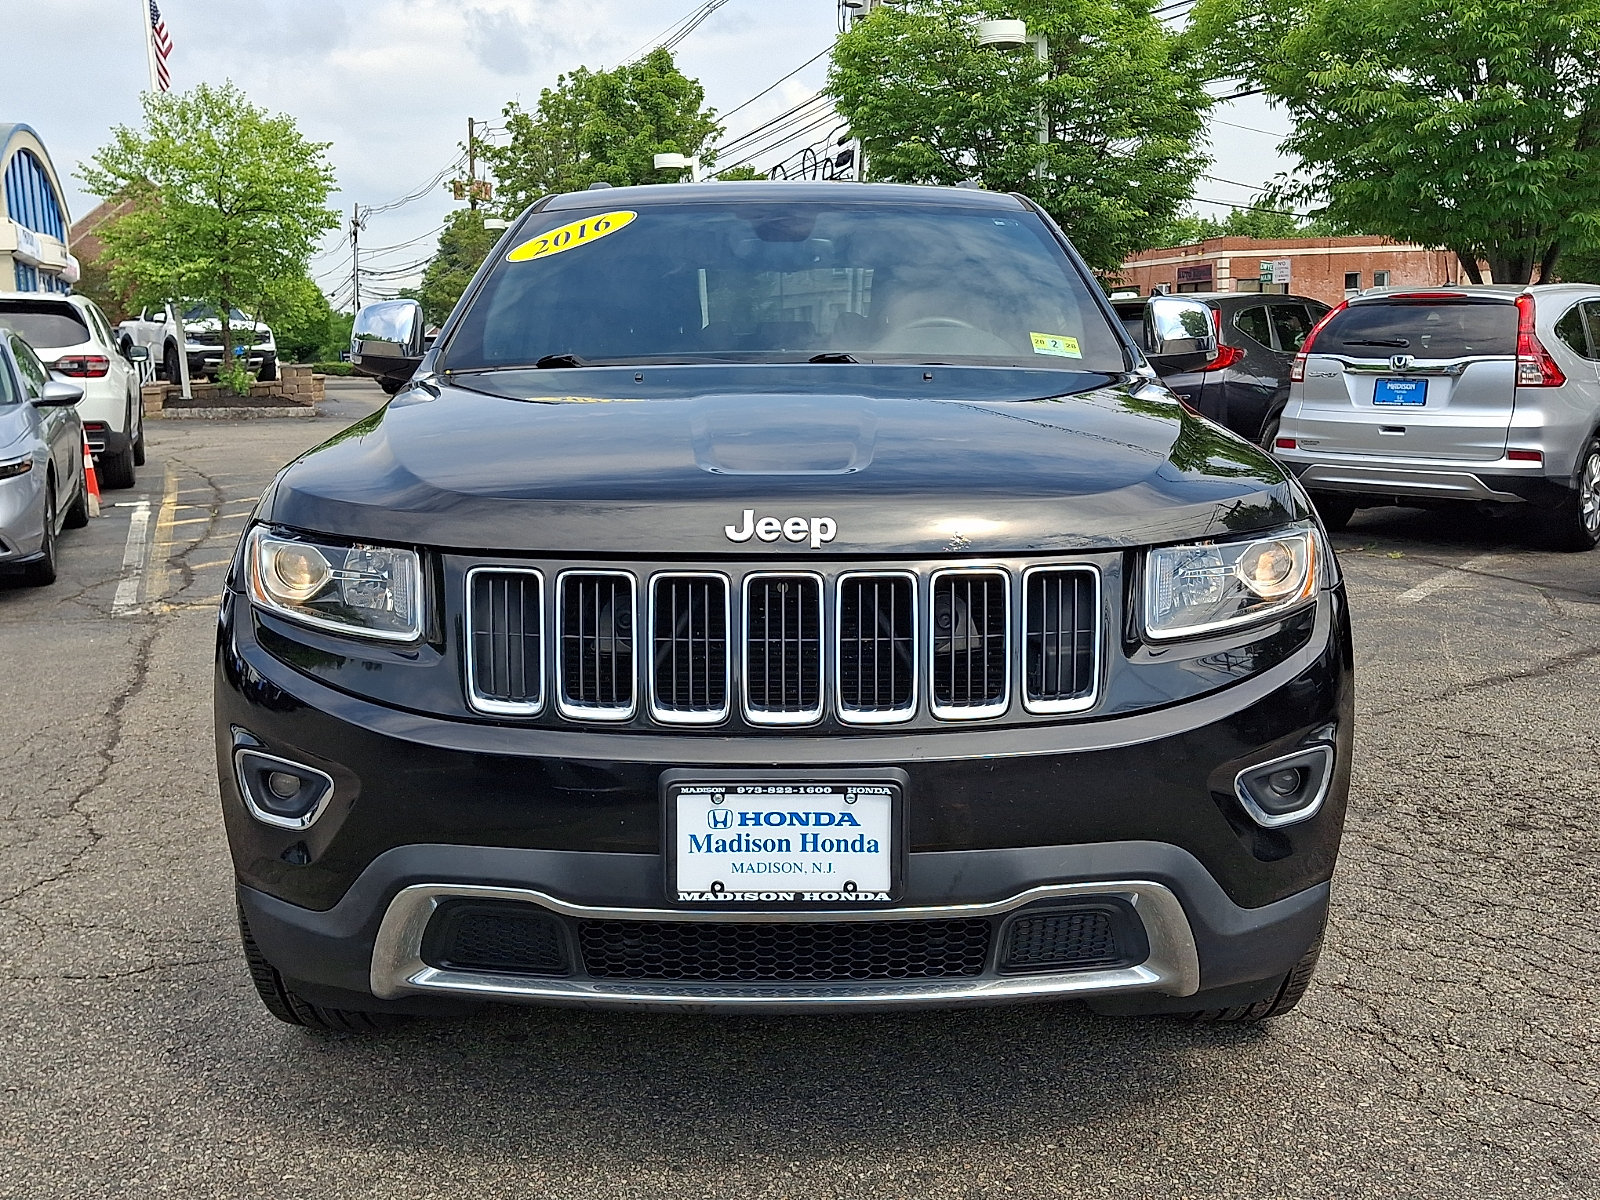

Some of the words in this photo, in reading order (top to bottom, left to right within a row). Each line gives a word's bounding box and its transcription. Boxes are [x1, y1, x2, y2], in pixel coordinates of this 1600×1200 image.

[533, 216, 611, 256] 2016
[1051, 339, 1059, 349] 2
[724, 509, 838, 550] Jeep
[847, 787, 892, 795] HONDA
[737, 811, 861, 827] HONDA
[688, 833, 792, 854] Madison
[799, 833, 880, 854] Honda
[731, 862, 808, 875] MADISON,
[811, 862, 836, 874] N.J.
[677, 892, 796, 902] MADISON
[801, 892, 892, 902] HONDA
